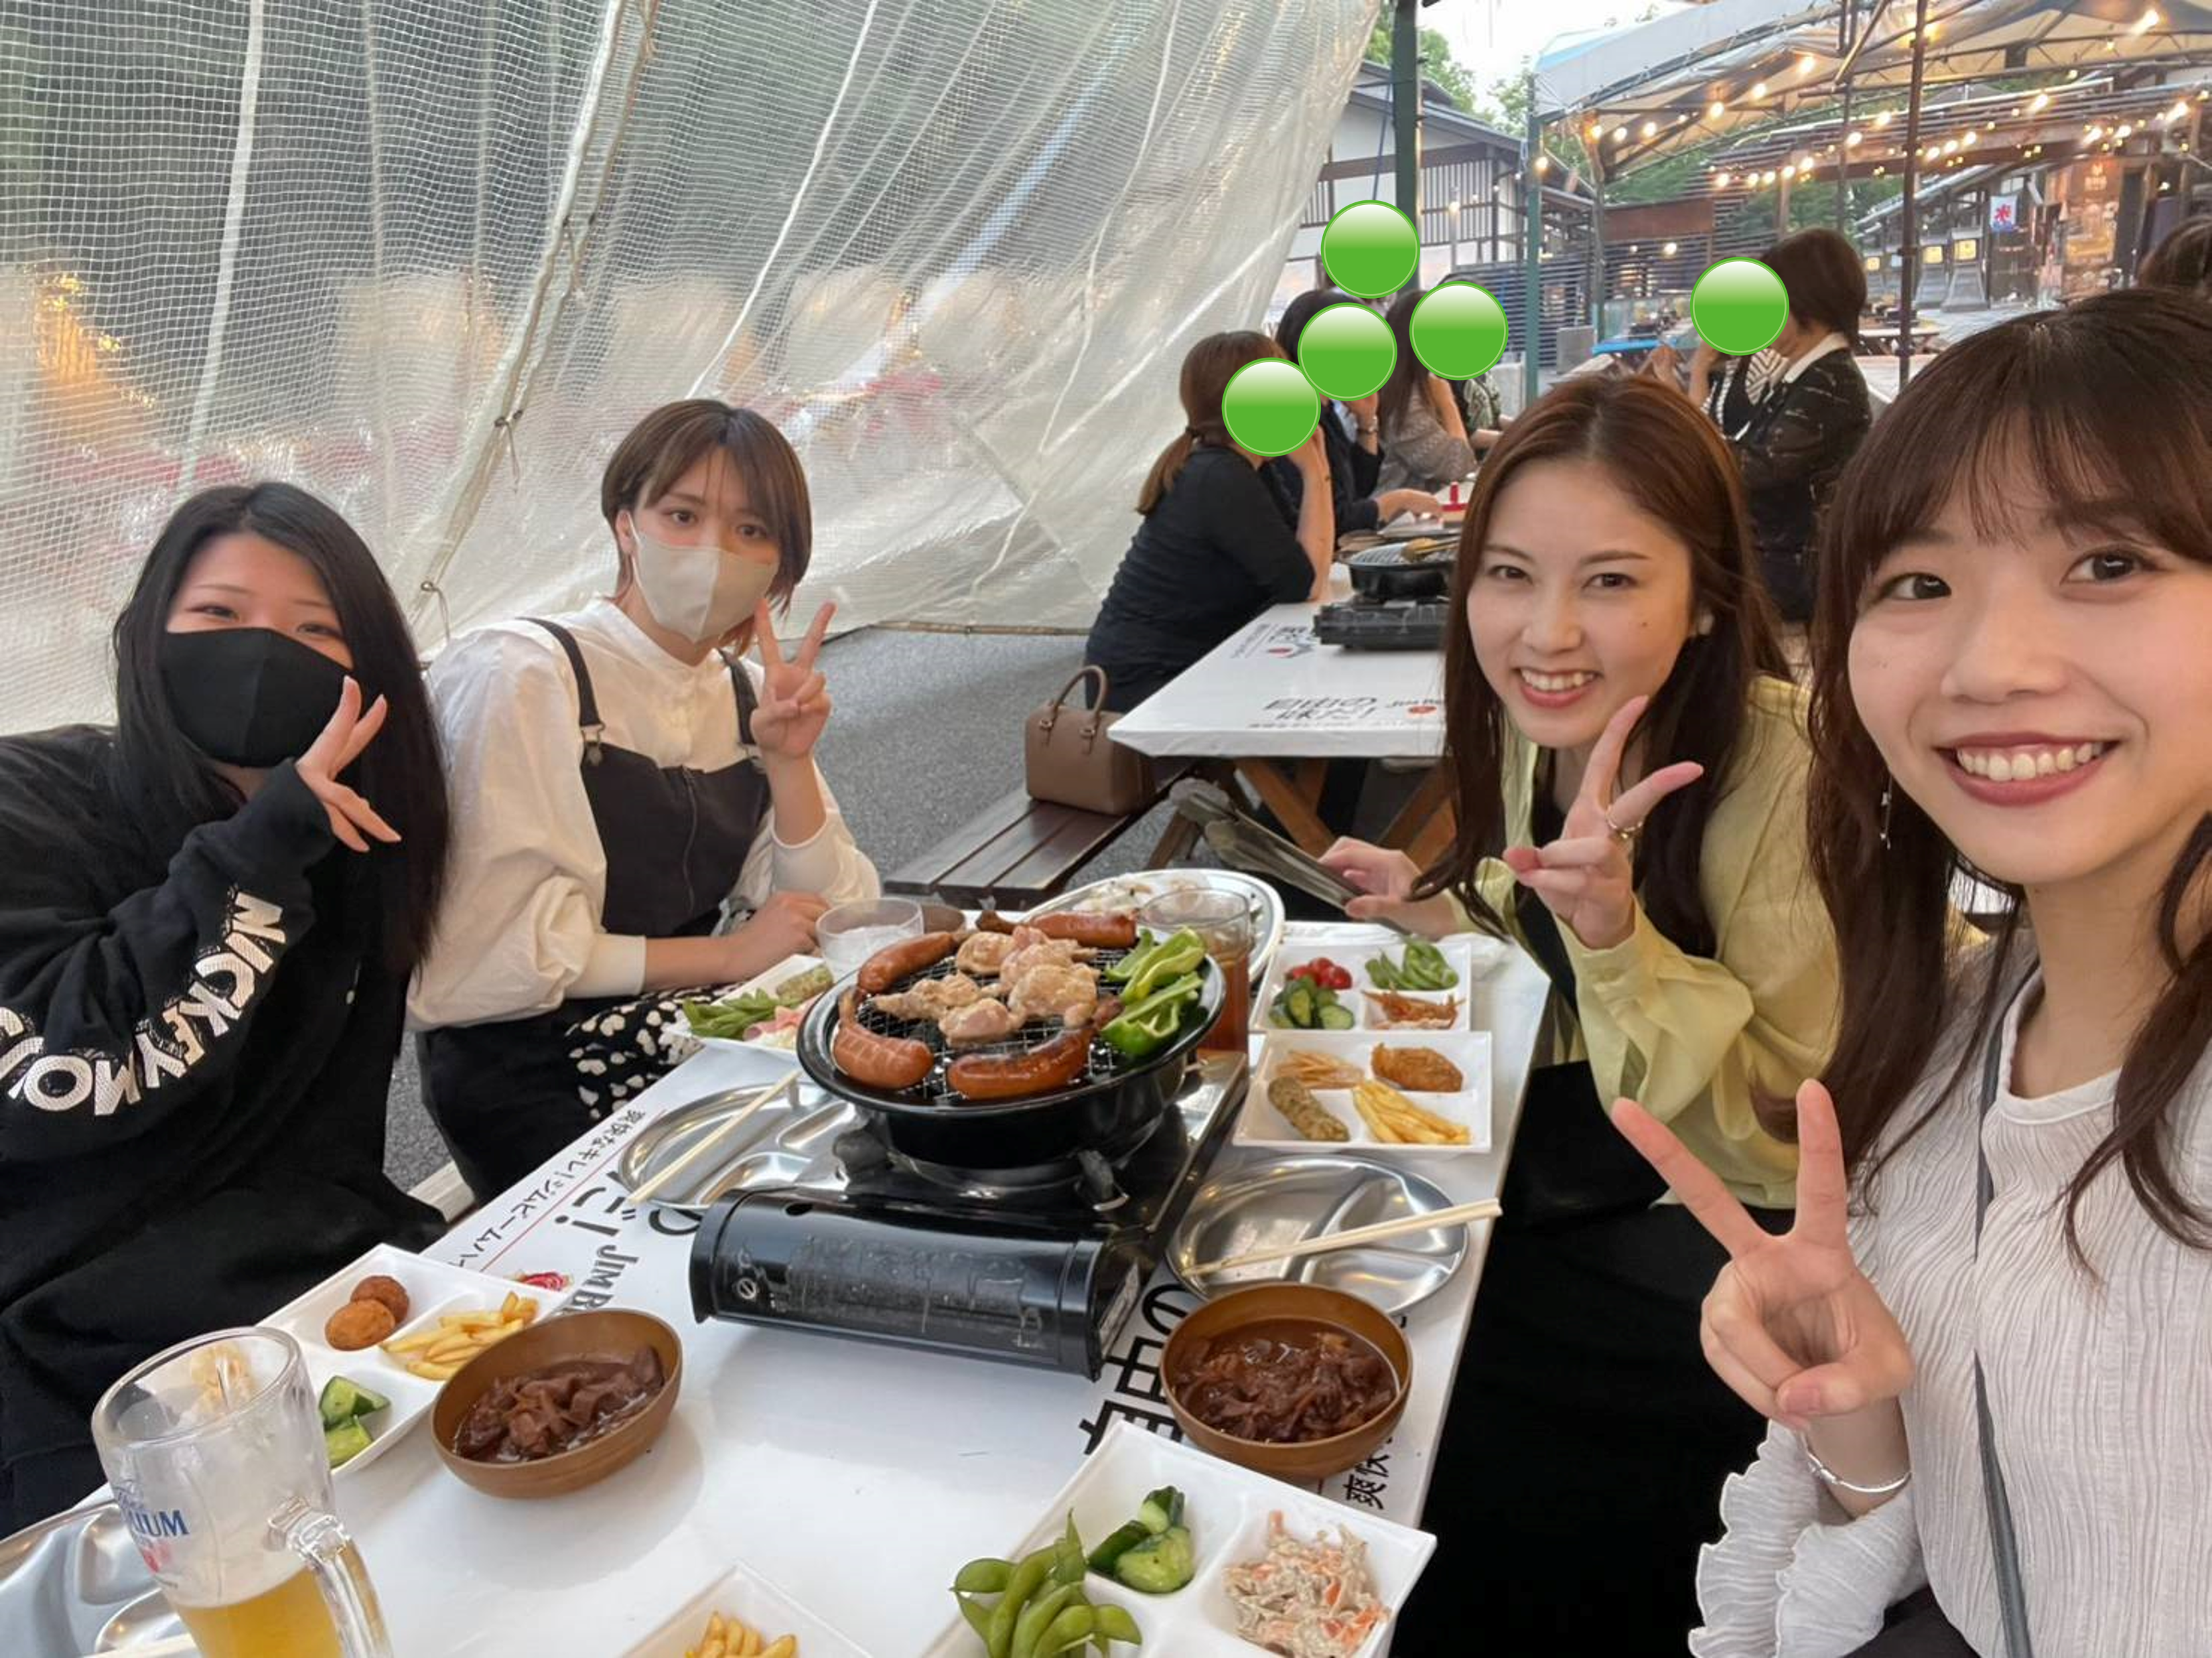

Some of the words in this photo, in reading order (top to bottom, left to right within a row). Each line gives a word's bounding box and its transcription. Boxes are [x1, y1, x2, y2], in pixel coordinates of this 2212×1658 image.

[135, 891, 286, 1089] MICKEY
[579, 1244, 640, 1296] JIM
[1342, 1437, 1393, 1510] 爽快
